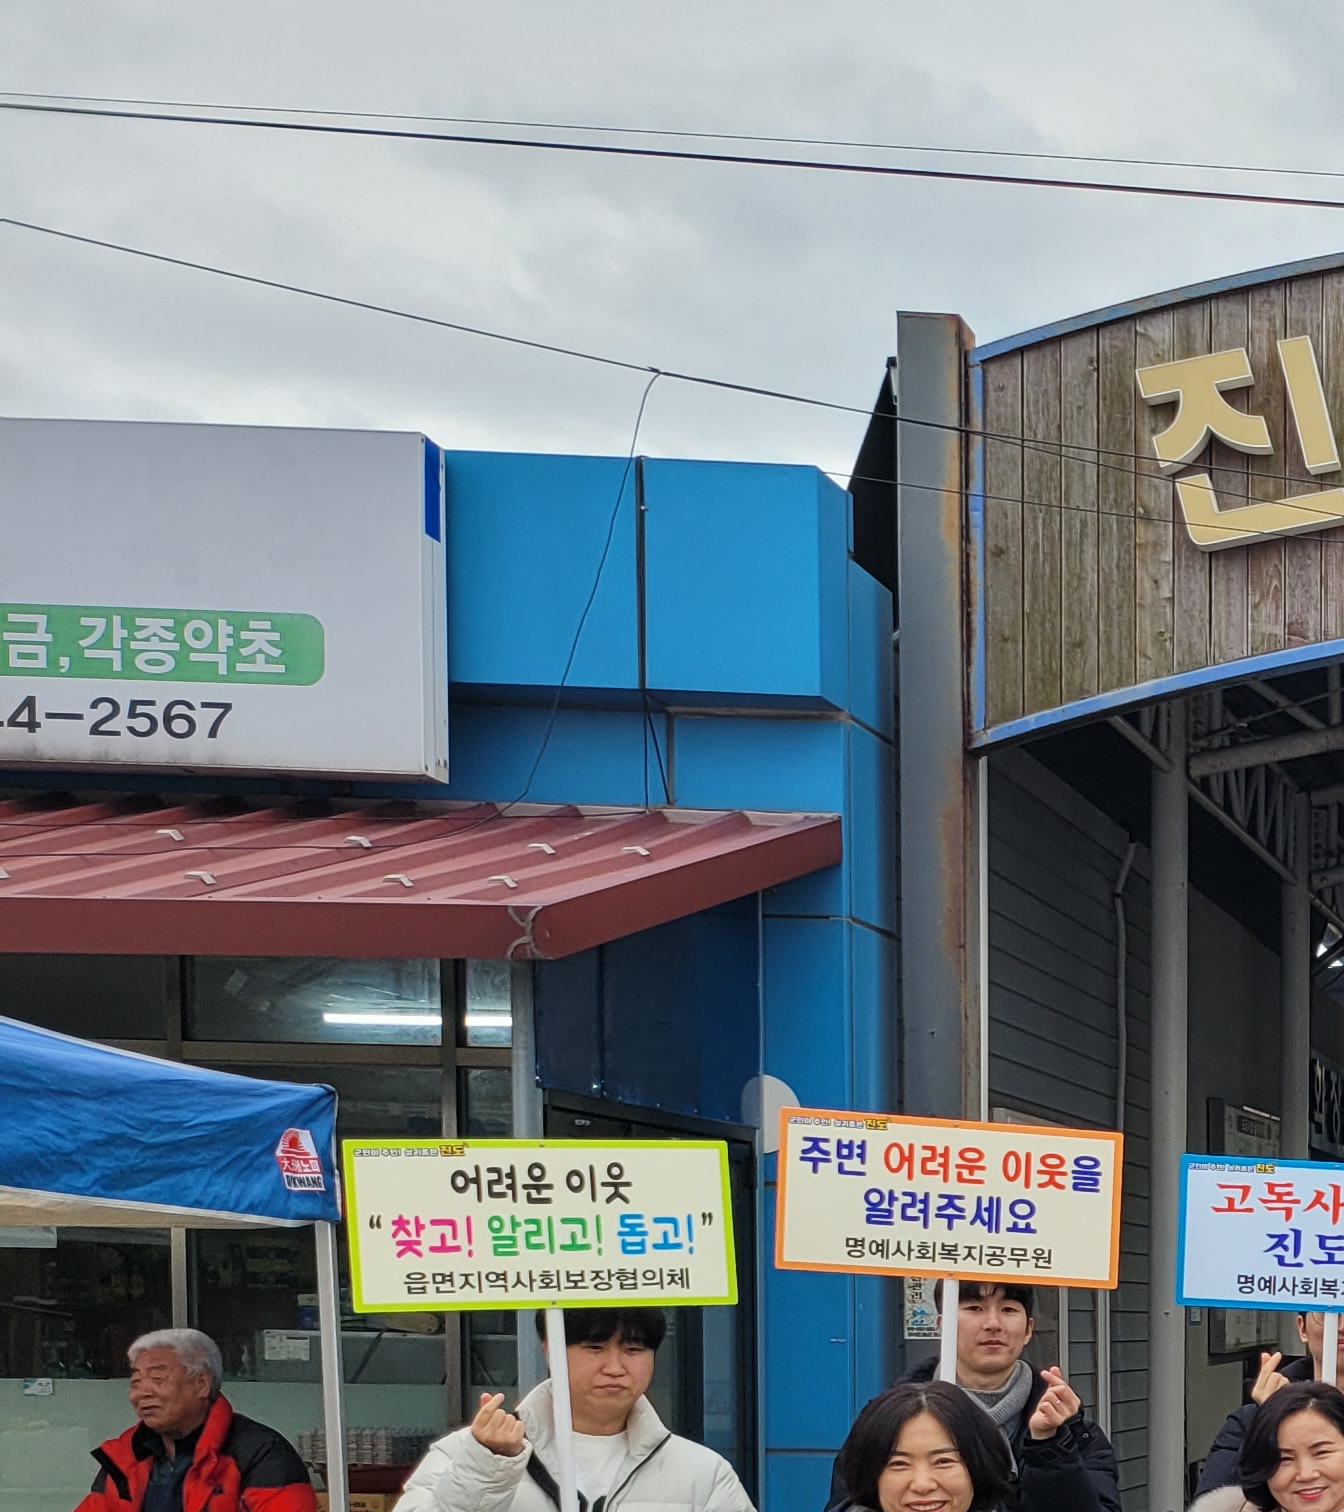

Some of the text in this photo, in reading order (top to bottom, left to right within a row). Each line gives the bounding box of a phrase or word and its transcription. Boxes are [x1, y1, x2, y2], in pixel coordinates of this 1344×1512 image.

[0, 694, 234, 740] 4-2567
[439, 1144, 466, 1157] 진도
[800, 1136, 1103, 1194] 주변 어려운 이웃을
[450, 1162, 633, 1205] 어려운 이웃
[863, 1187, 1038, 1235] 알려주세요
[487, 1215, 604, 1258] 알리고!
[845, 1236, 1053, 1270] 명예사회복지공무원
[403, 1267, 691, 1296] 읍면지역사회보장협의체
